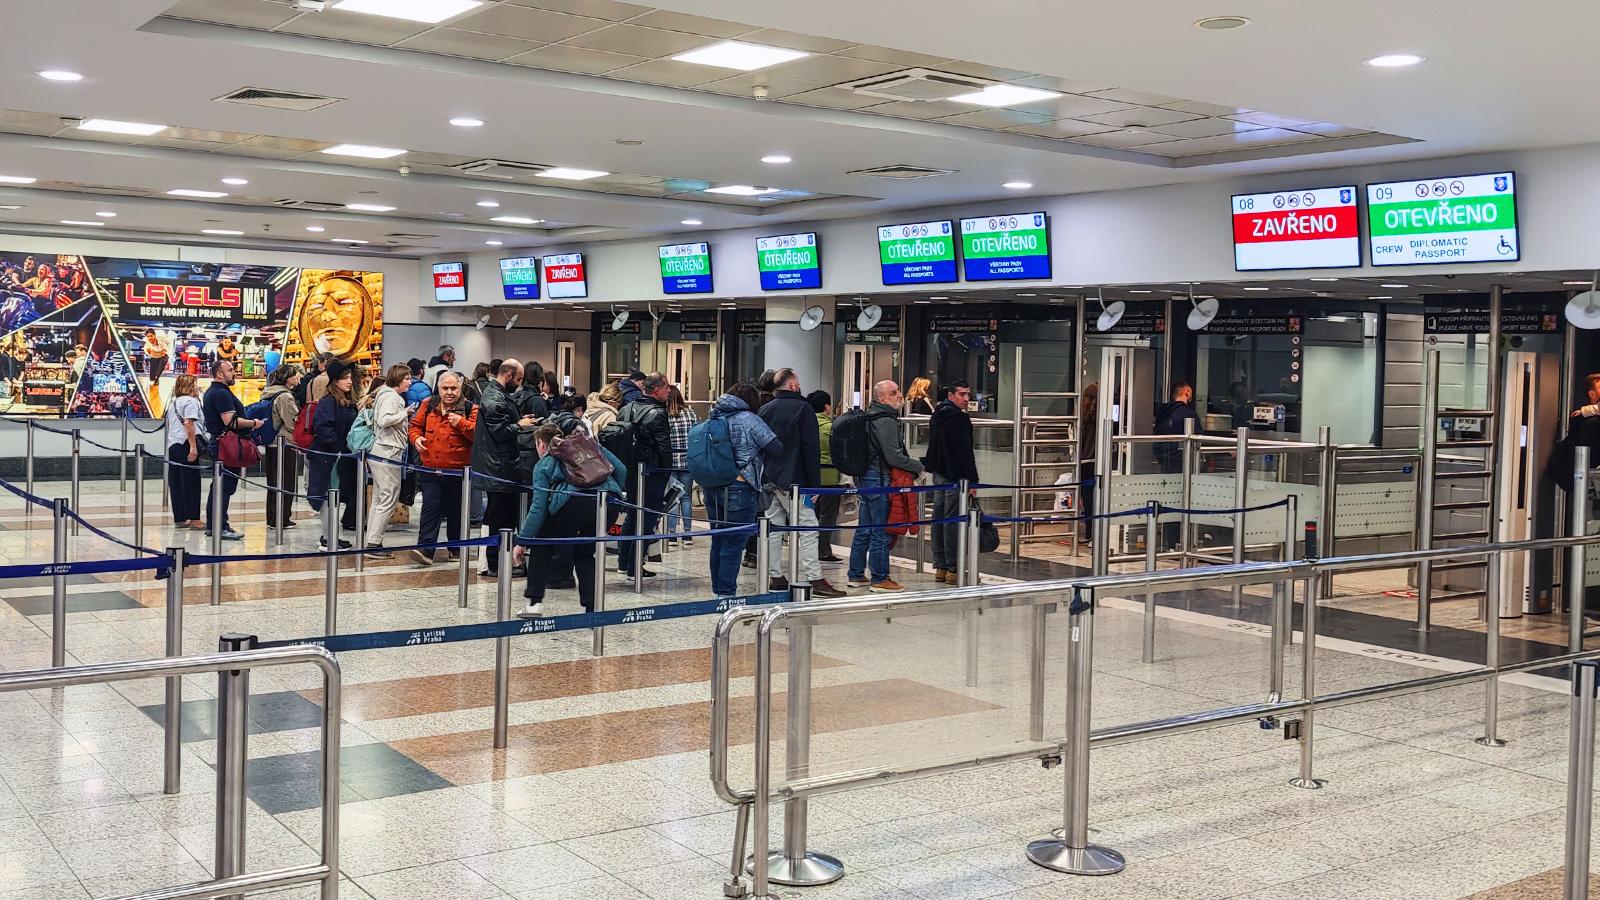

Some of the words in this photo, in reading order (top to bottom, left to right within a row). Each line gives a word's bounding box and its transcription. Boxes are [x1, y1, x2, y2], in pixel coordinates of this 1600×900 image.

[1376, 188, 1393, 200] 09
[1240, 199, 1254, 210] 08
[1384, 201, 1497, 229] OTEVŘENO
[966, 221, 976, 231] 07
[1252, 212, 1337, 237] ZAVŘENO
[882, 229, 892, 238] 06
[888, 239, 945, 259] OTEVŘENO
[972, 232, 1037, 253] OTEVŘENO
[1410, 237, 1468, 248] DIPLOMATIC
[1376, 245, 1403, 254] CREW
[1415, 248, 1467, 259] PASSPORT
[666, 257, 704, 272] OTEVŘENO
[764, 249, 811, 267] OTEVŘENO
[438, 273, 460, 286] ZAVŘENO
[505, 269, 533, 282] OTEVŘENO
[551, 266, 578, 280] ZAVŘENO
[125, 282, 241, 307] LEVELS
[243, 287, 268, 315] MAJ
[140, 306, 161, 316] BEST
[162, 307, 186, 318] NIGHT
[188, 308, 197, 318] IN
[199, 308, 232, 319] PRAGUE
[423, 636, 443, 644] Praha
[1361, 648, 1440, 664] STOP
